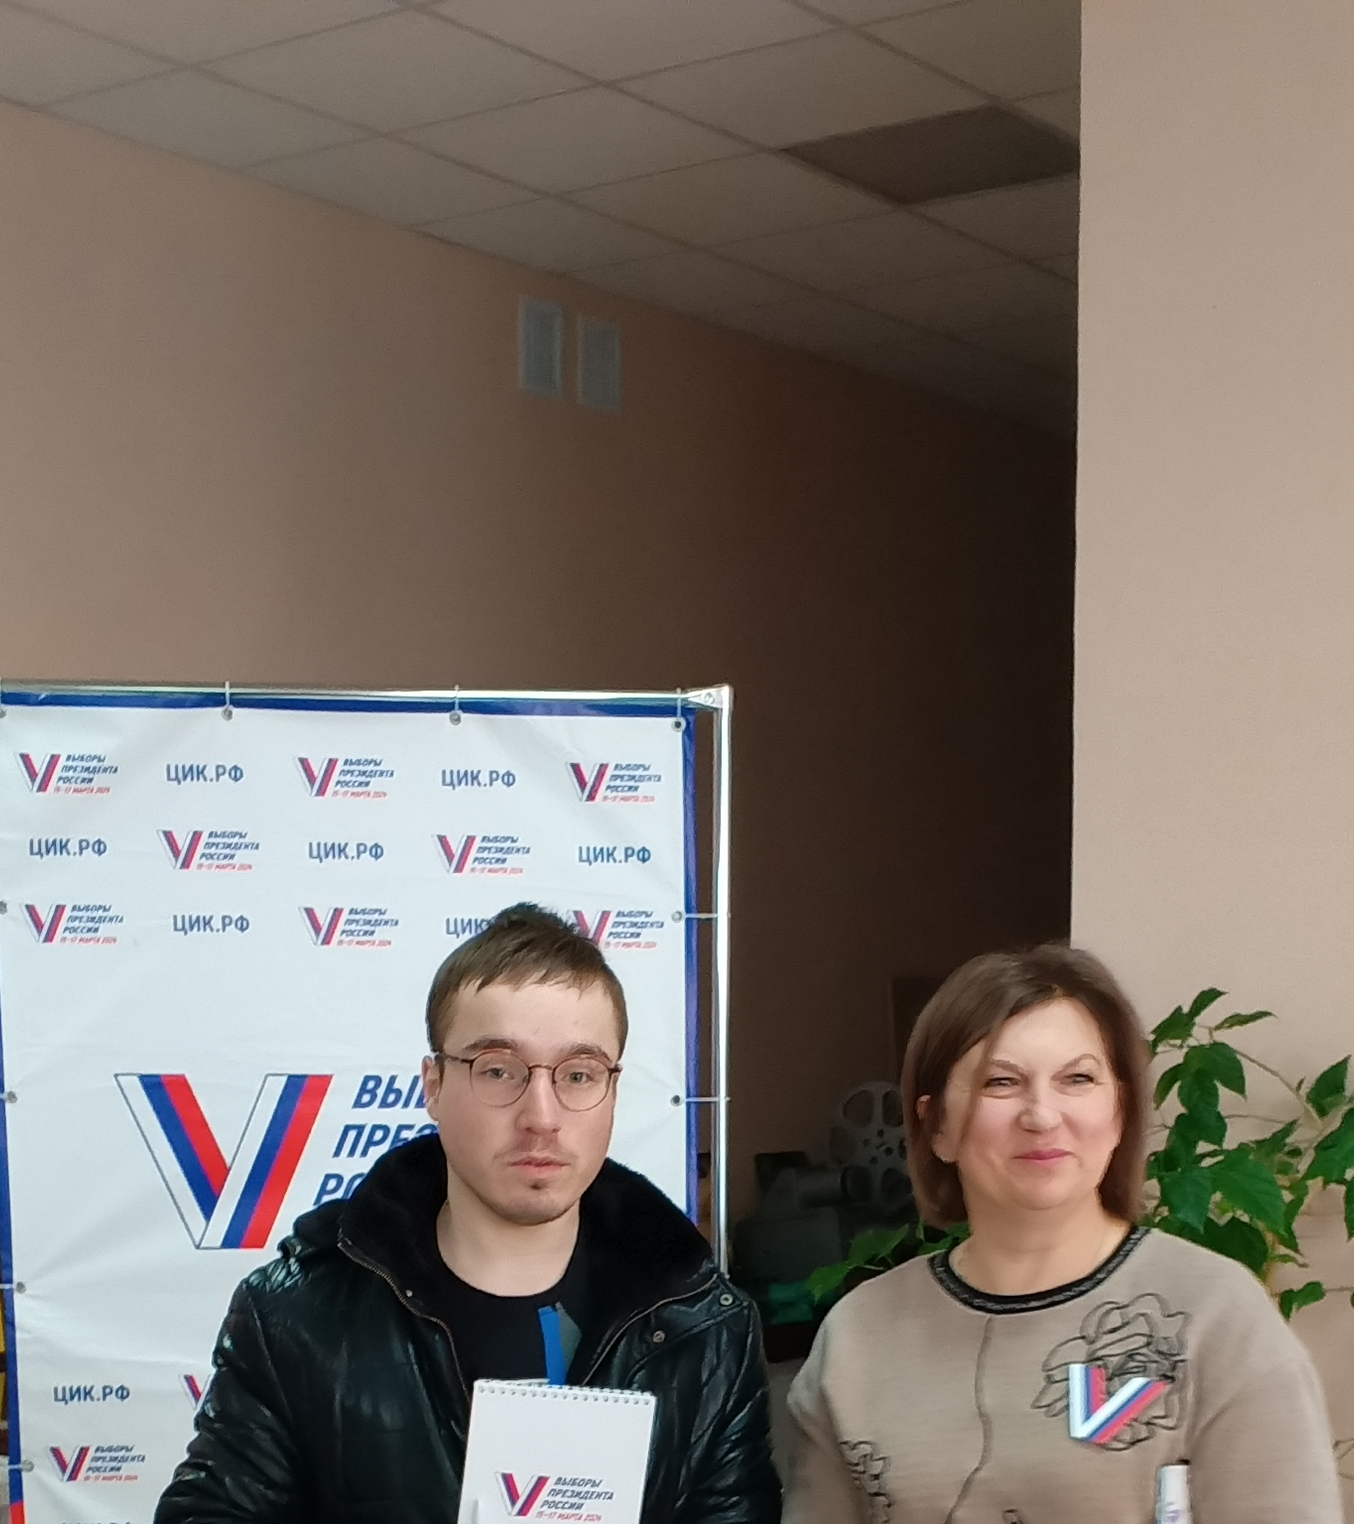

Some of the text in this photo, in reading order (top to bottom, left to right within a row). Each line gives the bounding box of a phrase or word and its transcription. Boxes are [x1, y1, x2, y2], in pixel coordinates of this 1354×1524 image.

[166, 763, 244, 785] ЦИК.РФ
[441, 769, 516, 790] ЦИК.РФ
[29, 838, 107, 859] ЦИК.РФ
[308, 842, 384, 863] ЦИК.РФ
[578, 846, 651, 866] ЦИК.РФ
[173, 915, 250, 936] ЦИК.РФ
[53, 1385, 130, 1405] ЦИК.РФ
[554, 1476, 603, 1488] ВЫБОРЫ
[547, 1488, 615, 1501] ПРЕЗИДЕНТА
[540, 1500, 585, 1511] РОССИИ
